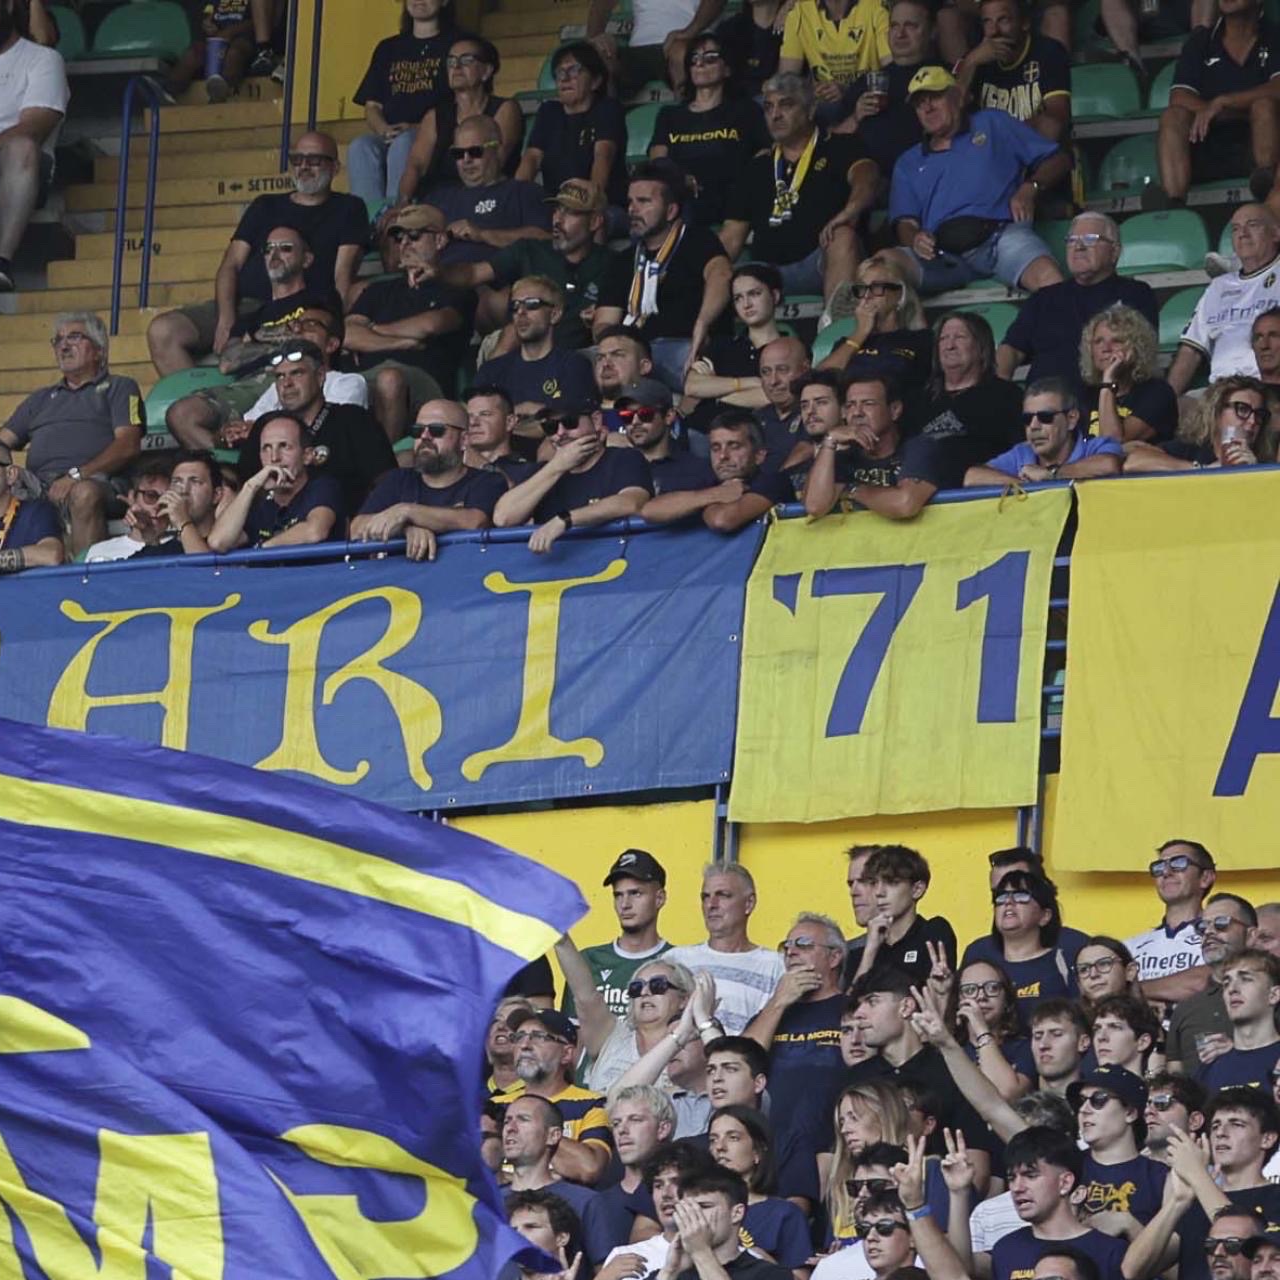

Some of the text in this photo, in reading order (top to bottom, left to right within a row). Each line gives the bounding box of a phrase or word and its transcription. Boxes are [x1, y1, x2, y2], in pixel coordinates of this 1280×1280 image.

[668, 129, 739, 145] VERONA
[247, 177, 296, 194] SETTOR
[807, 1029, 843, 1042] MORT
